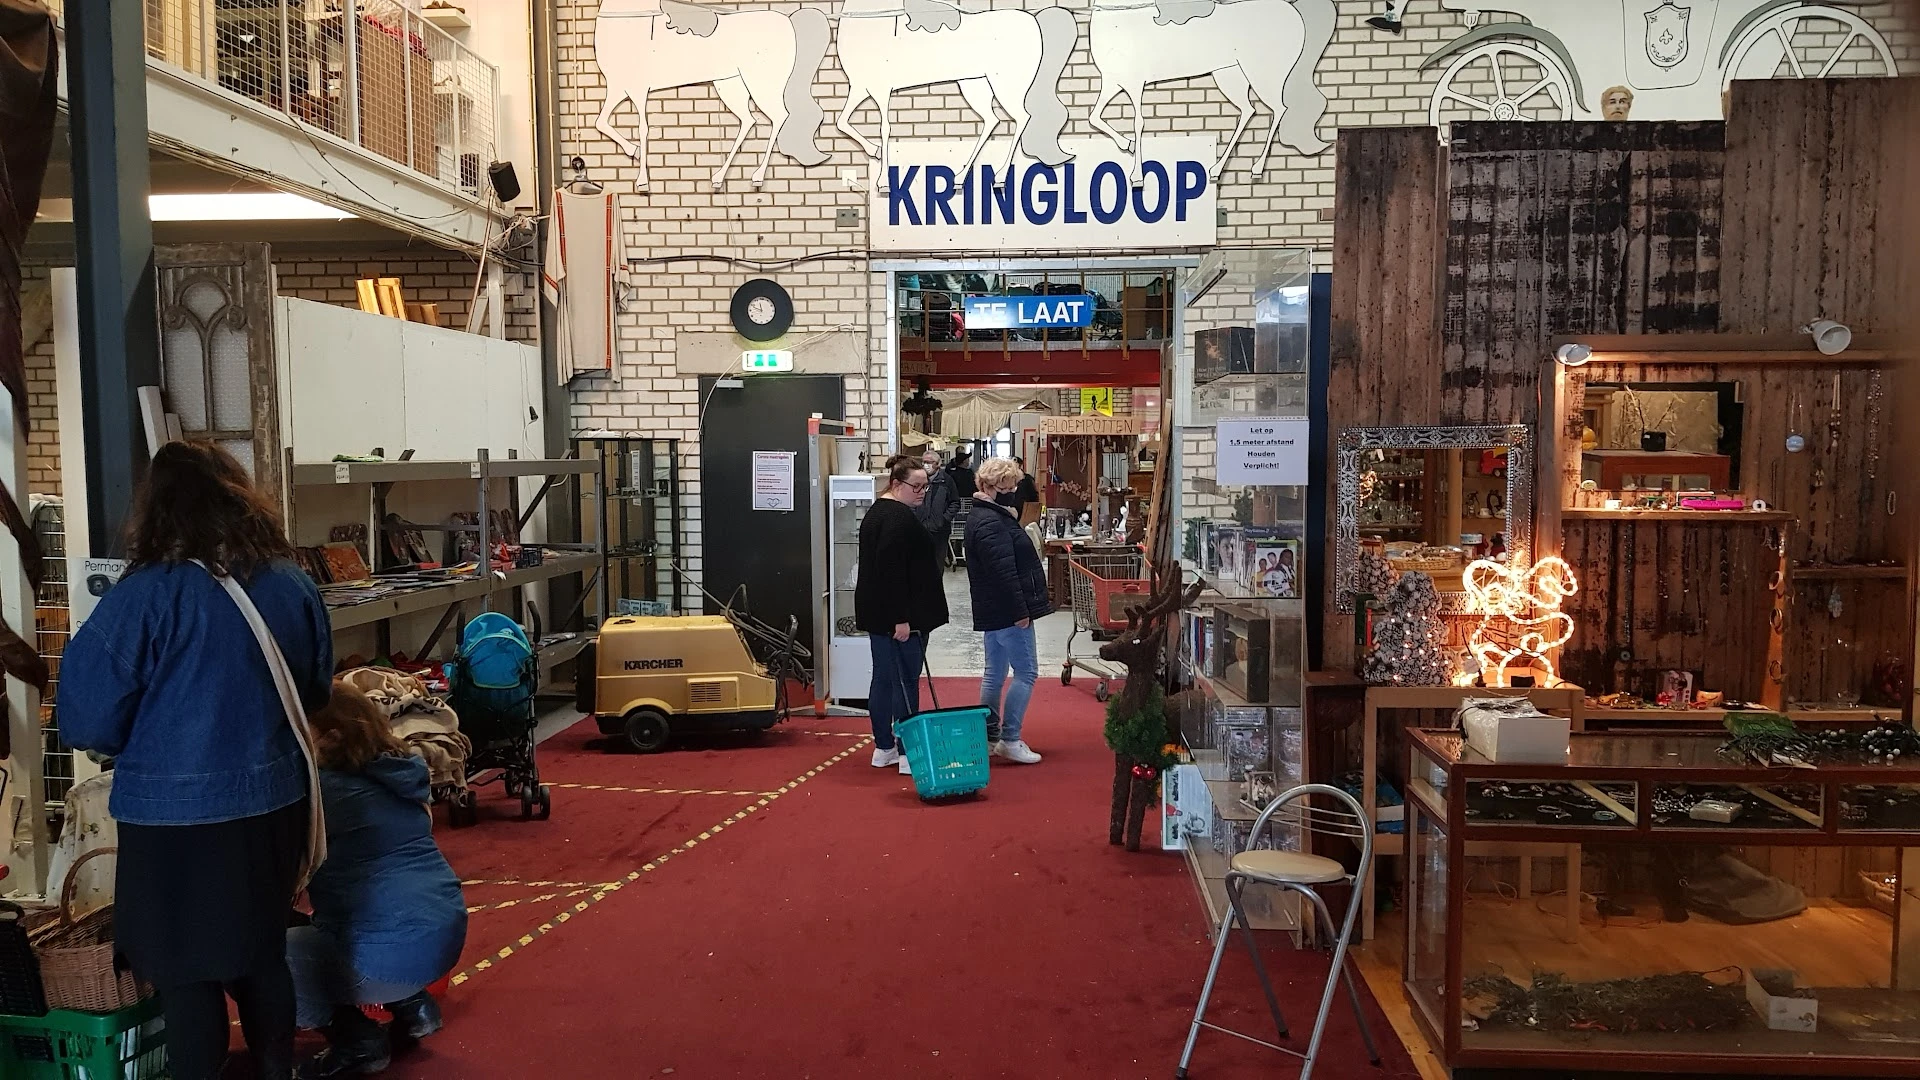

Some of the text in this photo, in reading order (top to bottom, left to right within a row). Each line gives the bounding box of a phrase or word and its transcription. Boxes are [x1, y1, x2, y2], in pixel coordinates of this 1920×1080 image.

[888, 160, 1207, 225] KRINGLOOP
[973, 301, 1085, 323] TE LAAT
[1047, 418, 1133, 434] BLOEMPOTTEN
[1266, 438, 1295, 446] afstand
[1247, 450, 1276, 458] Houden
[1243, 462, 1280, 470] Verplicht!
